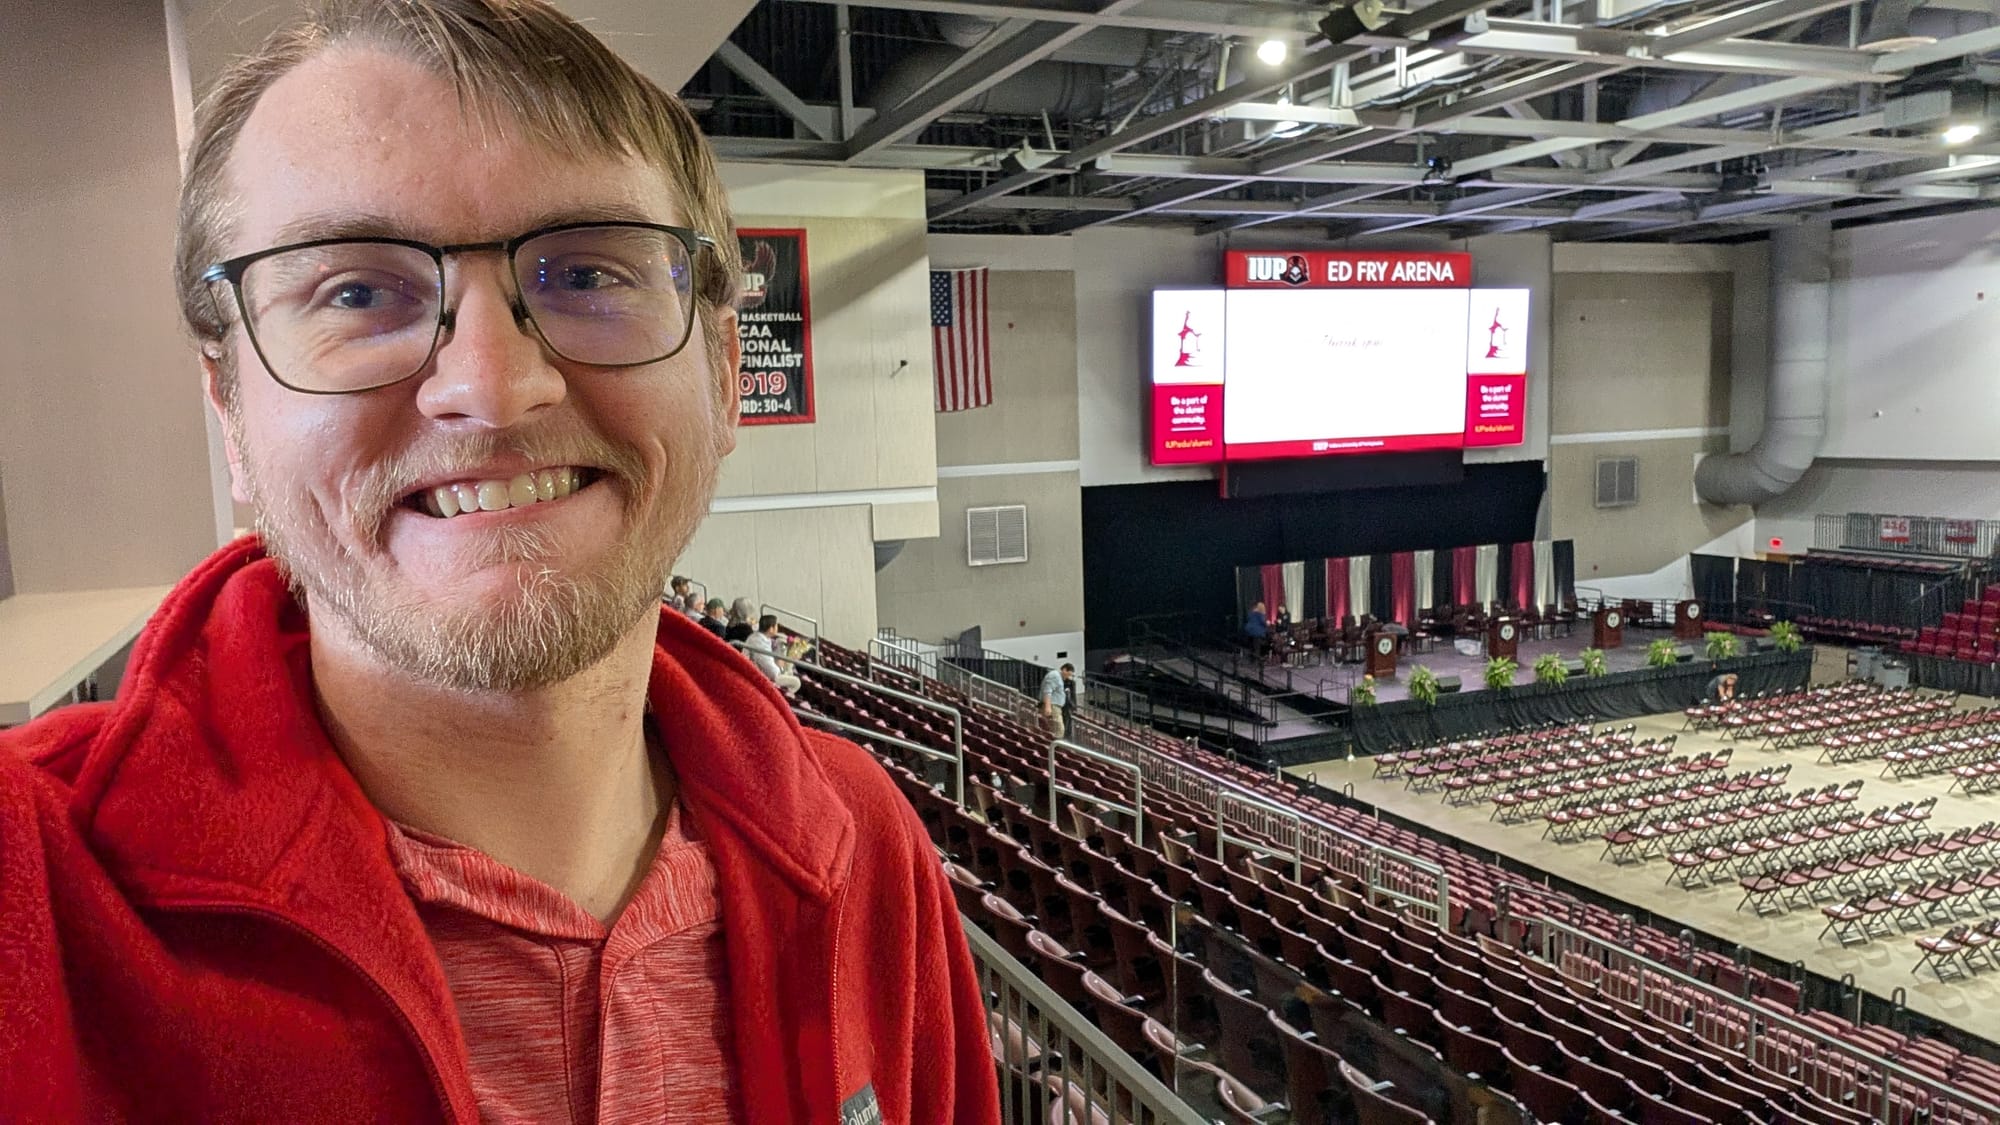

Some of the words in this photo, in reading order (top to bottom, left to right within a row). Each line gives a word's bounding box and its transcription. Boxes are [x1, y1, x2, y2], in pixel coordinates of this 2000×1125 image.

[1248, 256, 1288, 281] IUP
[1327, 260, 1353, 282] ED
[1356, 261, 1389, 282] FRY
[1391, 261, 1455, 282] ARENA
[743, 273, 765, 291] UP
[741, 312, 803, 321] BASKETBALL
[739, 324, 773, 338] CAA
[741, 339, 792, 353] IONAL
[740, 354, 803, 368] FINALIST
[739, 371, 787, 396] 019
